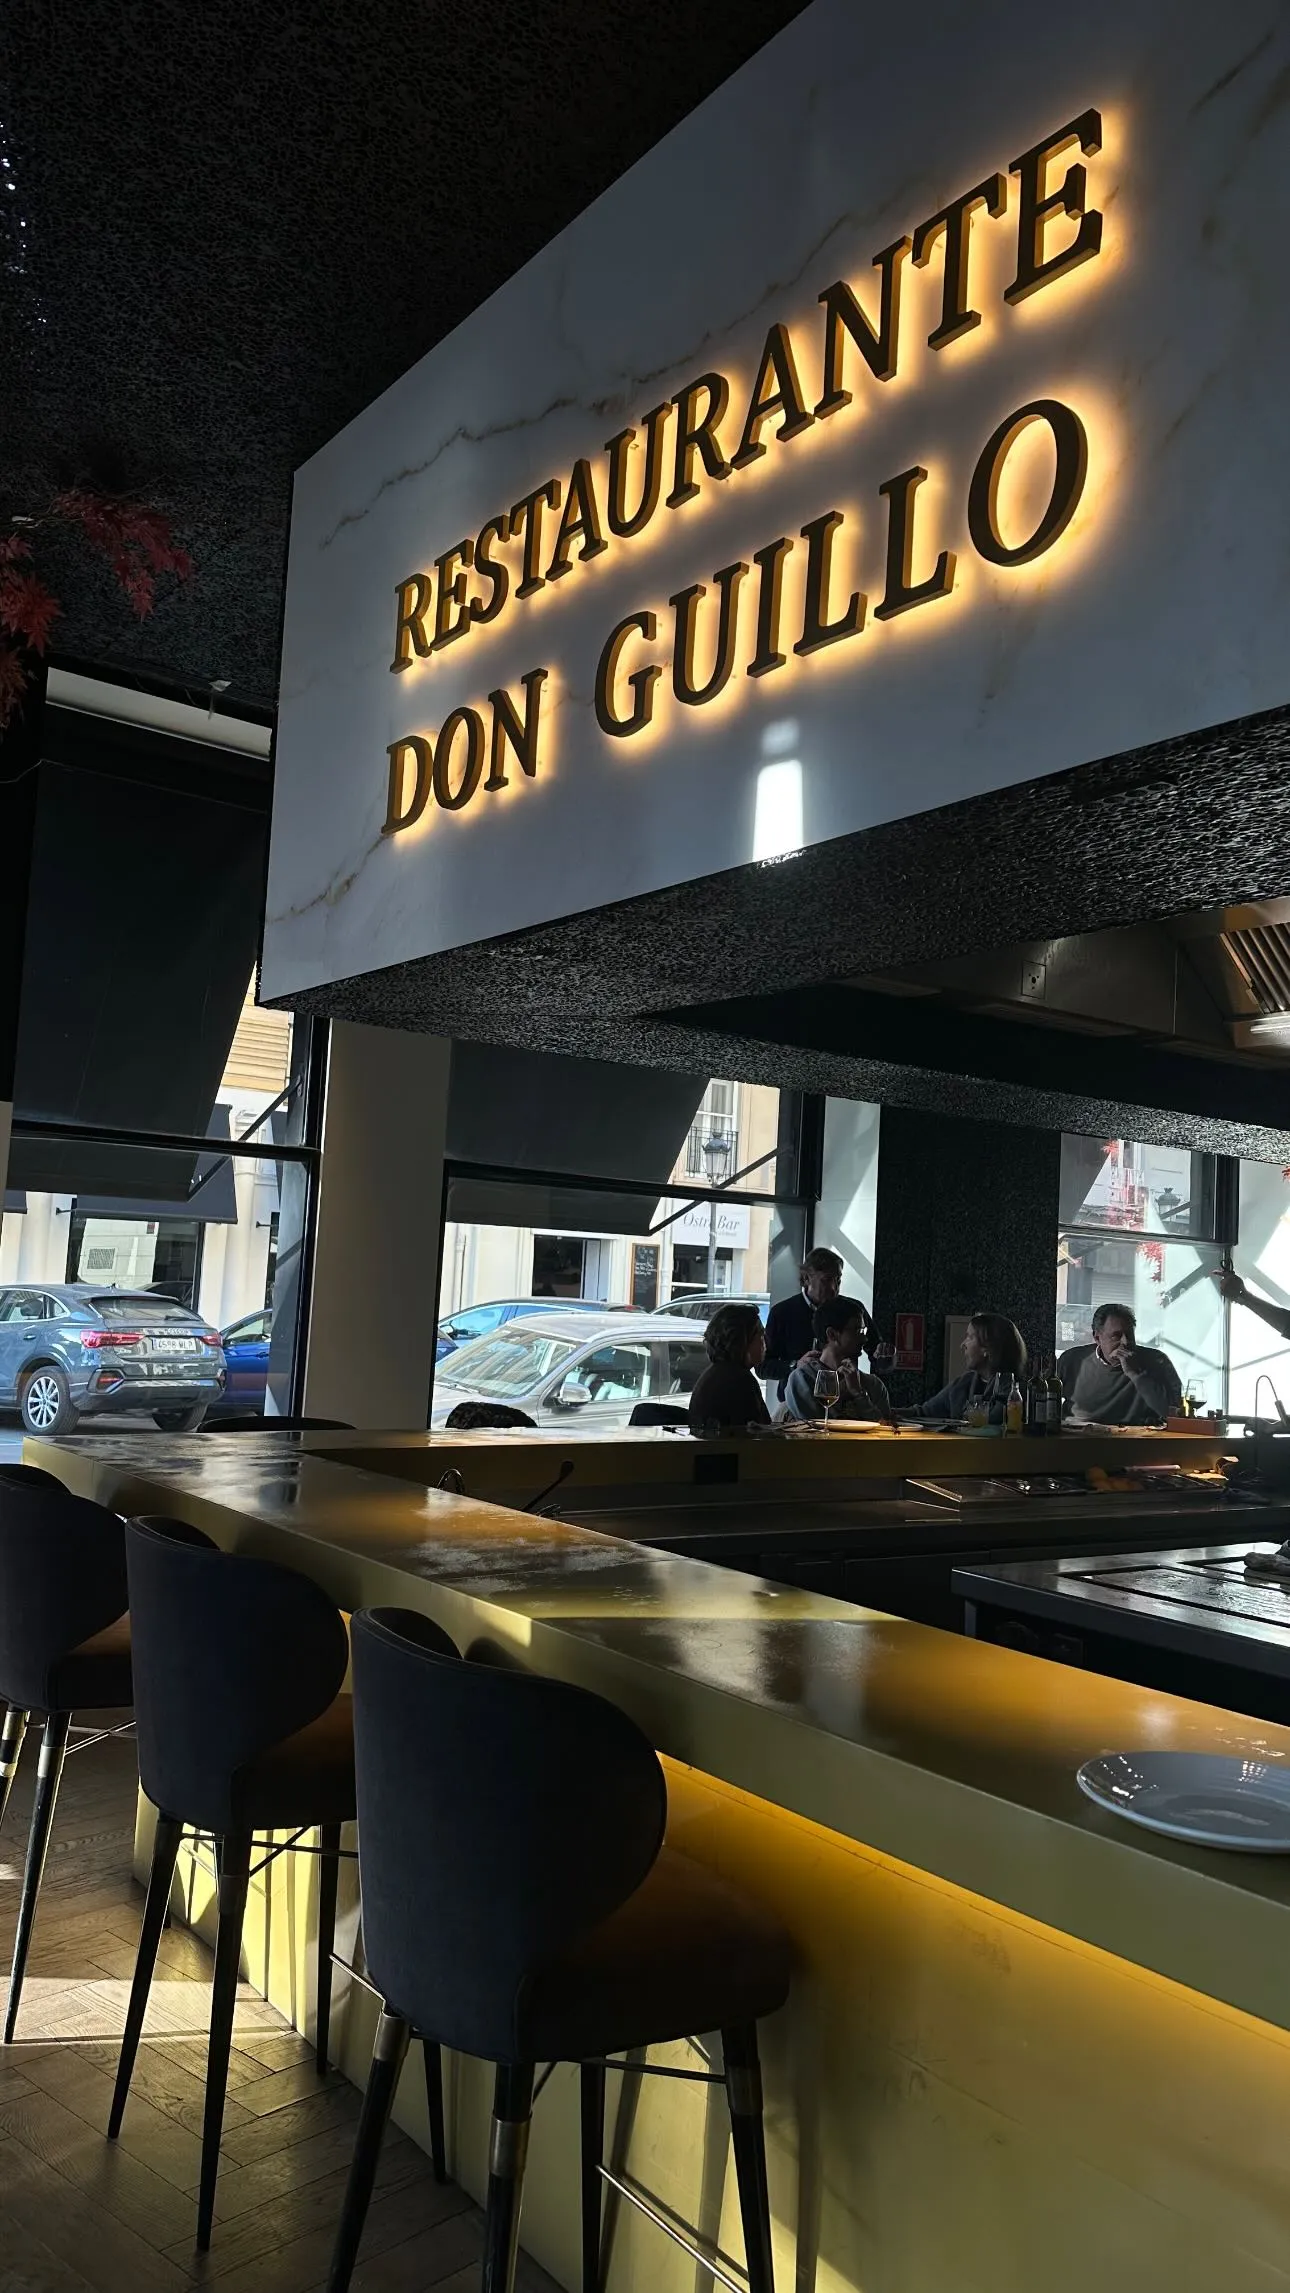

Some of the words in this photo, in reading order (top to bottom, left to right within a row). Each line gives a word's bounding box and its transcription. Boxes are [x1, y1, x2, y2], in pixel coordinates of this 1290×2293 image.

[390, 108, 1102, 674] RESTAURANTE
[381, 667, 548, 835] DON
[594, 399, 1088, 737] GUILLO
[683, 1212, 711, 1228] Ostr
[717, 1215, 740, 1230] Bar
